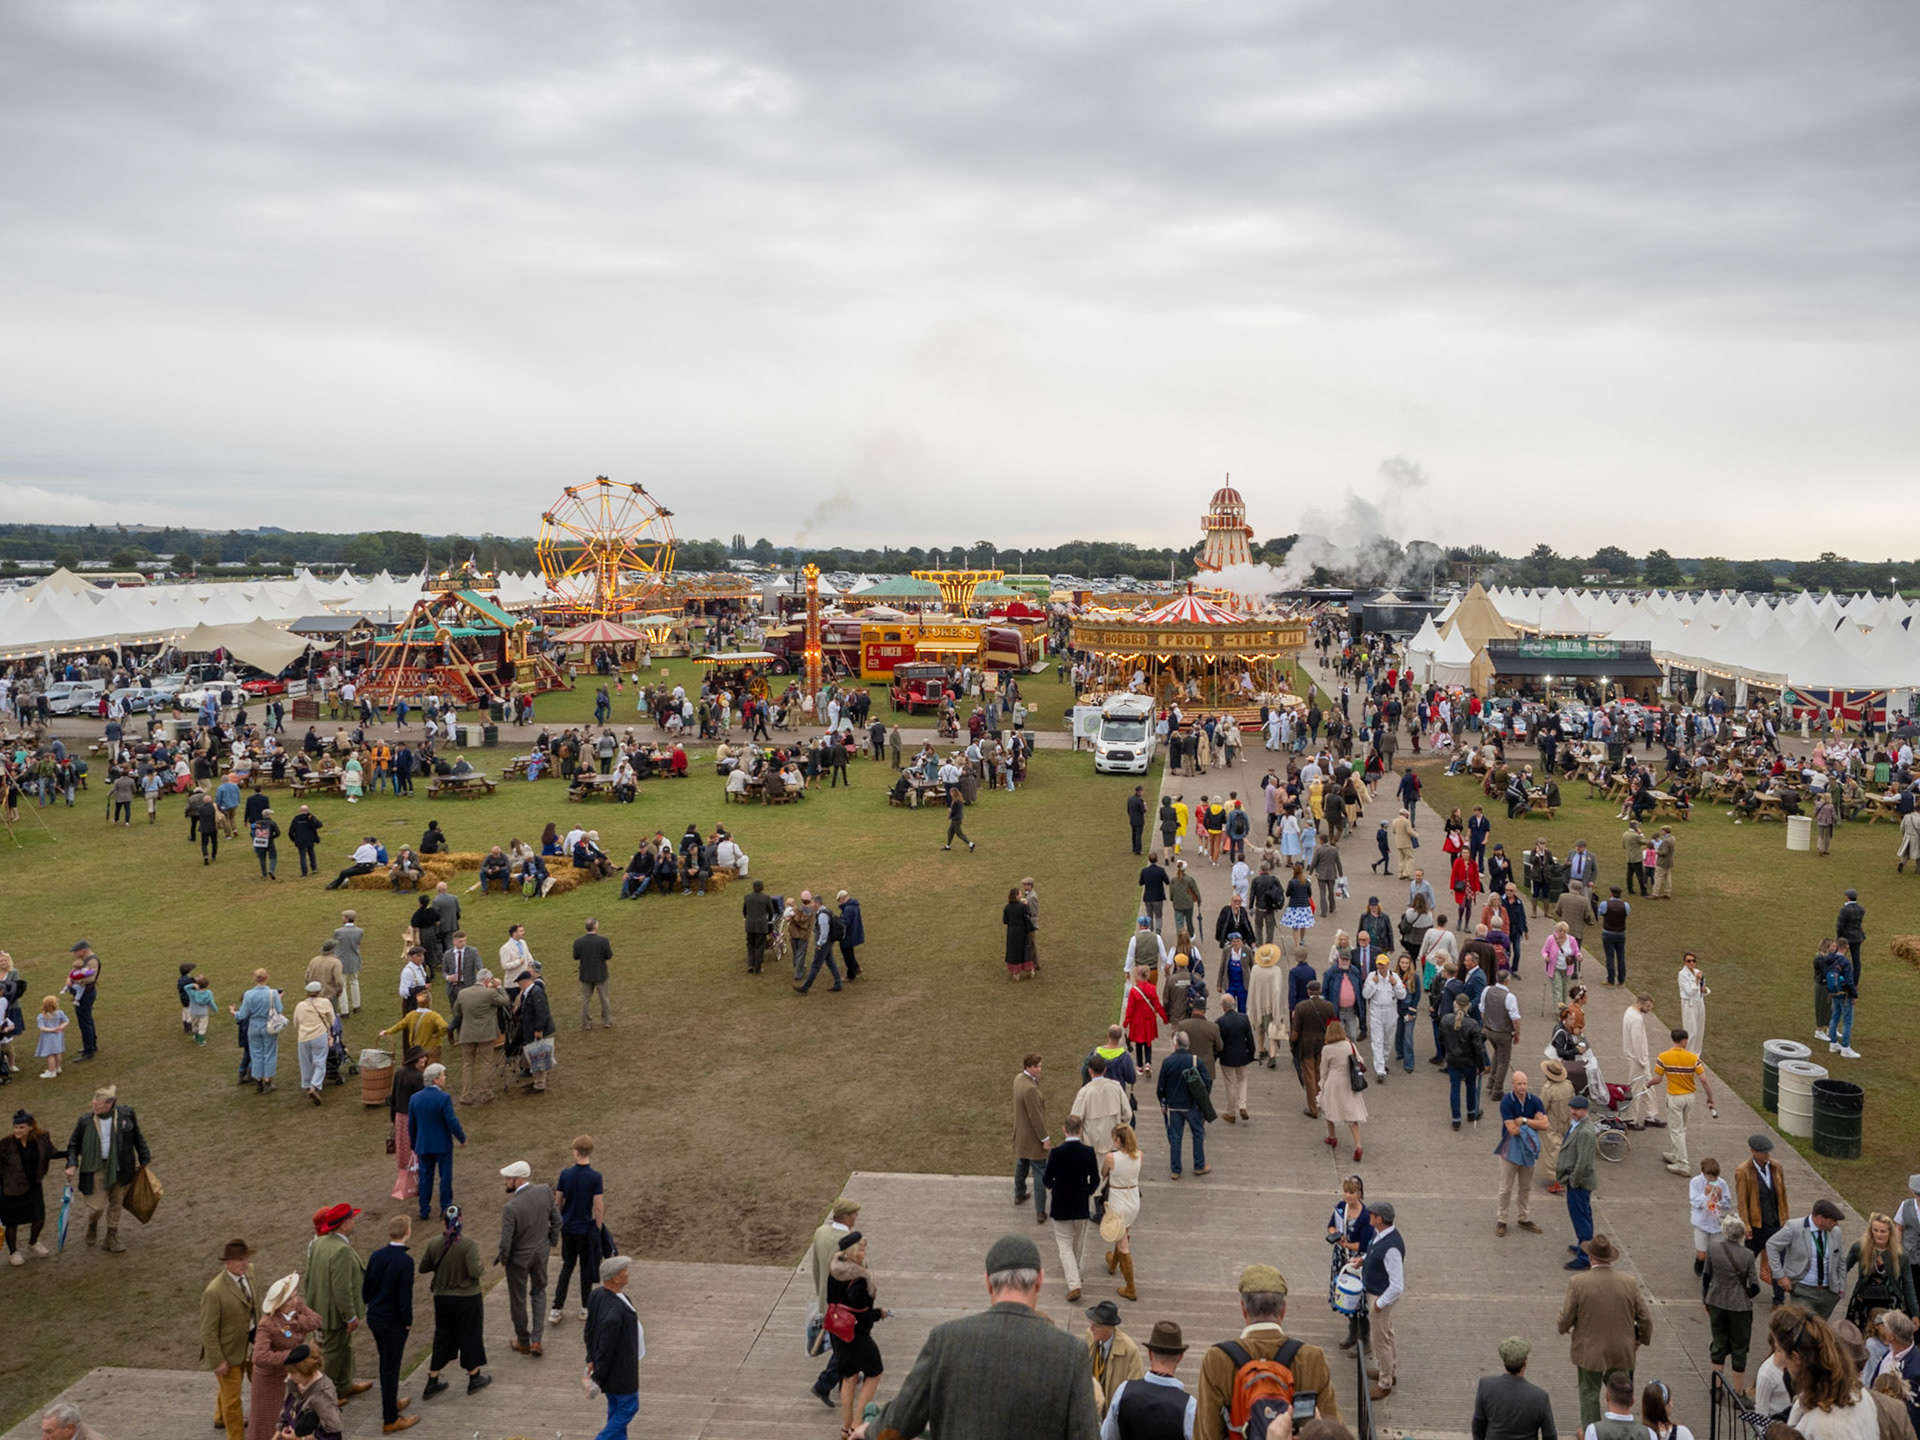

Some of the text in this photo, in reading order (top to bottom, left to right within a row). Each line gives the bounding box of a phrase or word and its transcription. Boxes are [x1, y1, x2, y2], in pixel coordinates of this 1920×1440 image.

[924, 627, 976, 639] TOKENS
[1105, 633, 1146, 644] HORSES
[1165, 634, 1206, 646] FROM
[1282, 632, 1302, 644] PAST
[1557, 641, 1582, 649] TOTAL
